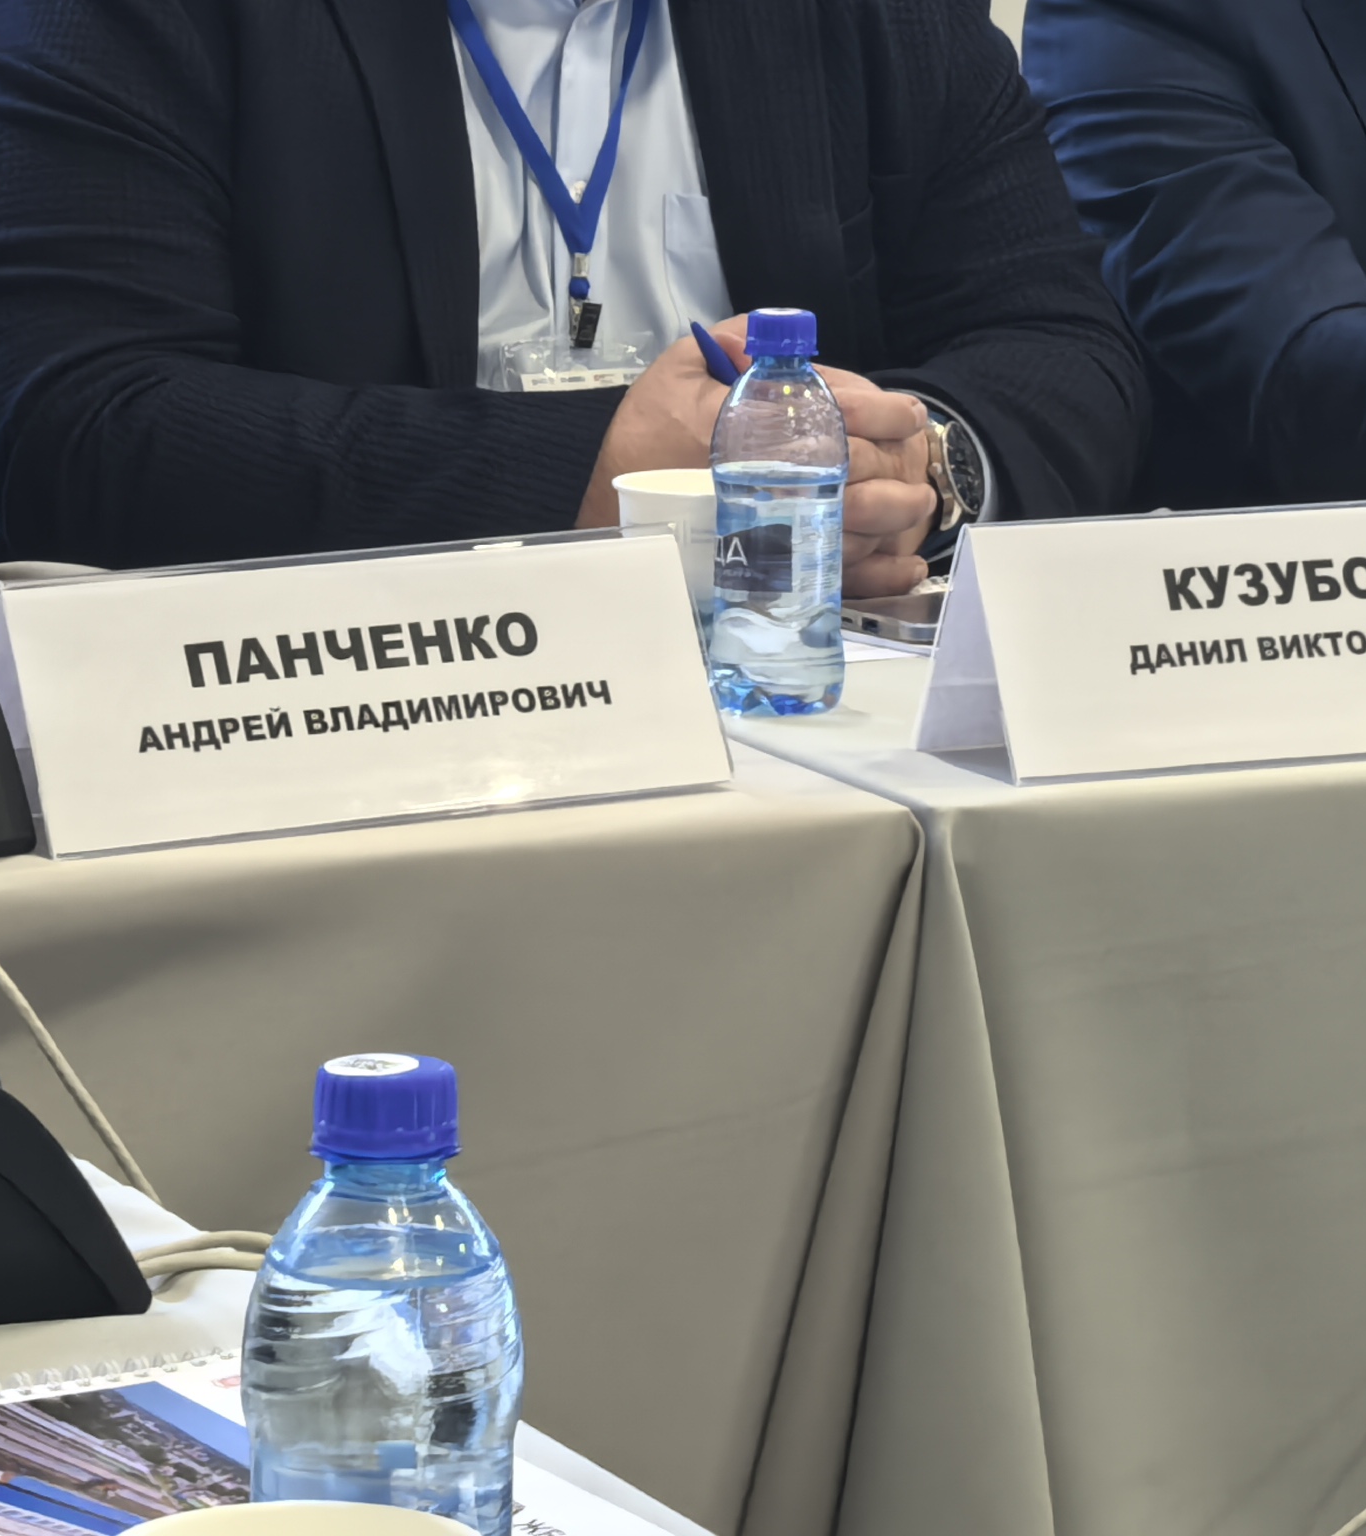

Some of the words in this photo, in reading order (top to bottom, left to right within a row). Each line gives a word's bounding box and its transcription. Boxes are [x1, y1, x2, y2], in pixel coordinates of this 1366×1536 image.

[184, 611, 539, 688] ПАНЧЕНКО
[1129, 638, 1248, 676] ДАНИЛ
[138, 707, 293, 754] АНДРЕЙ
[303, 679, 612, 735] ВЛАДИМИРОВИЧ
